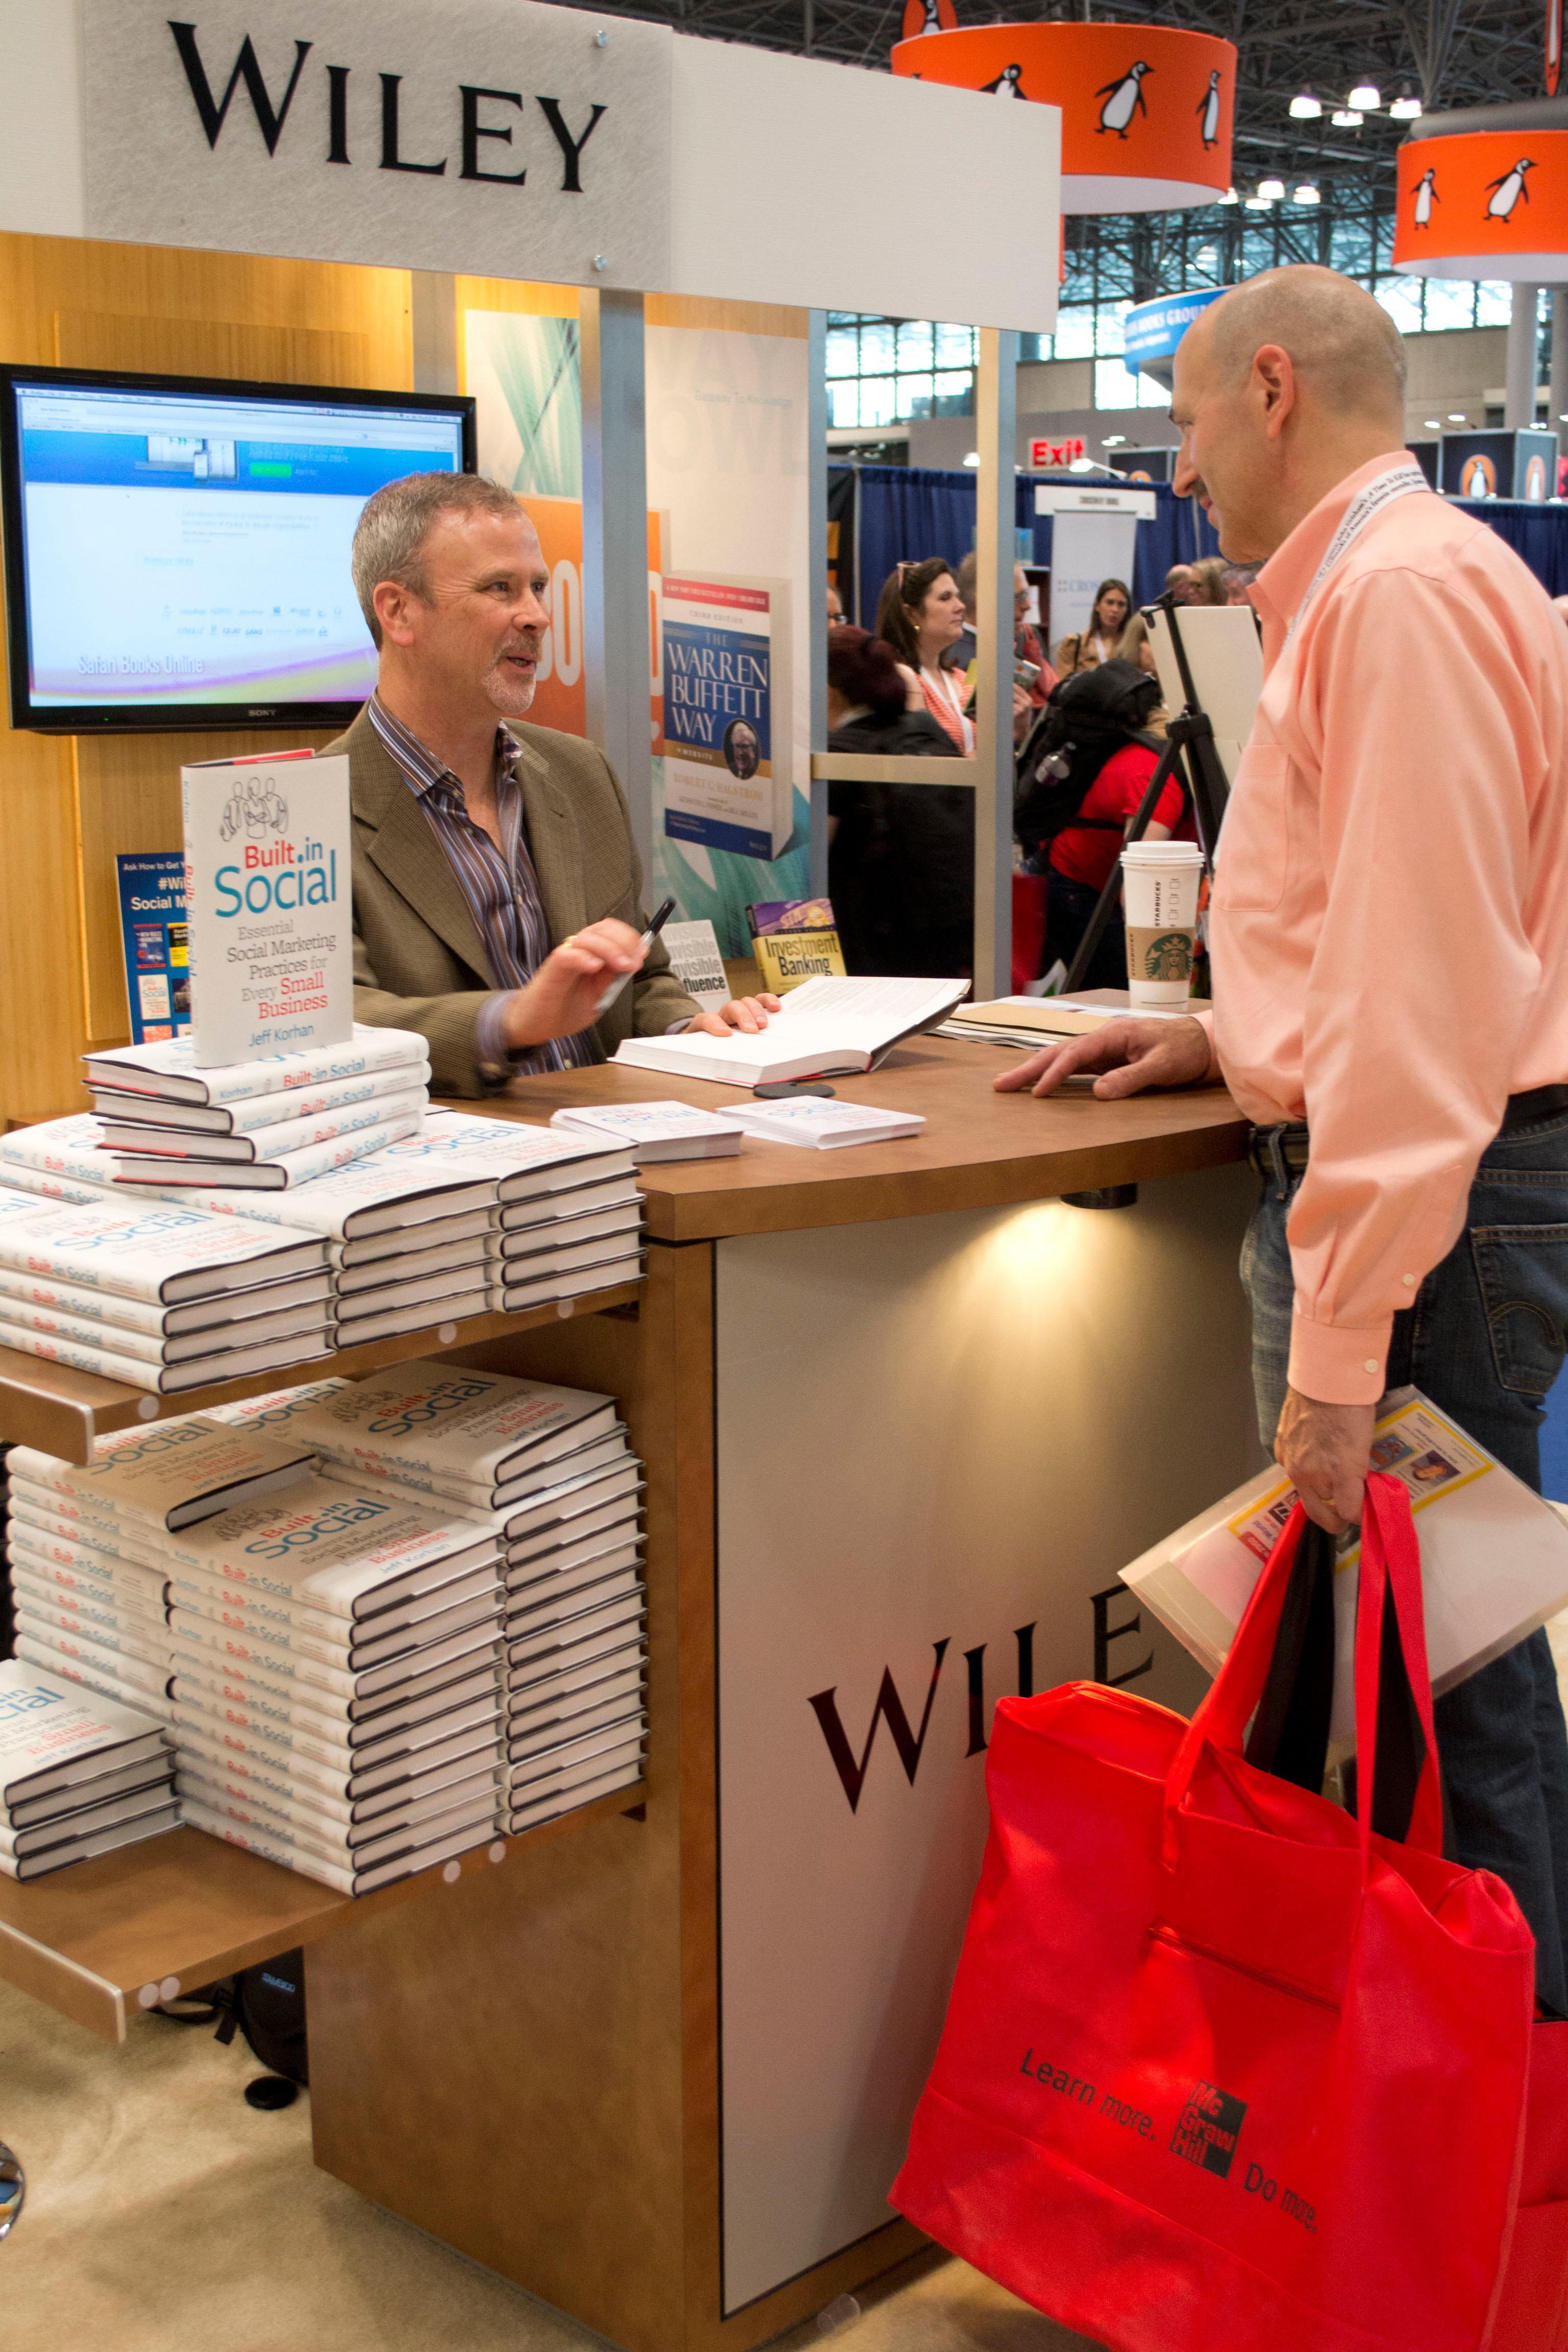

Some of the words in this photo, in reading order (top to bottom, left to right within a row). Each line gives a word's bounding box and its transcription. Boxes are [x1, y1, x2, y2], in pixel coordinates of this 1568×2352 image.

[167, 20, 608, 193] WILEY
[1032, 438, 1085, 466] Exit
[705, 632, 727, 646] THE
[78, 656, 116, 674] Safari
[120, 656, 160, 674] Books
[164, 656, 204, 673] Online
[667, 642, 768, 688] WARREN
[671, 674, 765, 718] BUFFETT
[671, 706, 716, 742] WAY
[123, 863, 137, 871] Ask
[138, 862, 155, 870] How
[156, 862, 164, 870] to
[165, 861, 179, 869] Get
[214, 849, 337, 918] Social
[131, 896, 172, 911] Social
[237, 920, 295, 941] Essential
[227, 942, 267, 963] Social
[272, 934, 337, 958] Marketing
[668, 938, 717, 959] nvisible
[765, 934, 840, 958] Investment
[249, 959, 308, 979] Practices
[310, 955, 329, 970] for
[672, 957, 722, 977] nvisible
[778, 954, 834, 976] Banking
[241, 985, 278, 1002] Every
[280, 971, 325, 995] Small
[258, 994, 329, 1020] Business
[248, 1028, 273, 1047] Jeff
[274, 1024, 315, 1043] Korhan
[219, 1086, 253, 1099] Korhan
[283, 1067, 327, 1087] Built-in
[331, 1058, 365, 1077] Social
[241, 1116, 273, 1130] Korhan
[300, 1095, 340, 1115] Built-in
[343, 1084, 375, 1104] Social
[601, 1110, 699, 1124] Social
[352, 1111, 380, 1129] Social
[364, 1132, 387, 1150] Social
[386, 1124, 526, 1158] Social
[78, 1164, 105, 1182] Social
[249, 1209, 281, 1225] Social
[53, 1210, 213, 1251] Social
[67, 1266, 99, 1285] Social
[71, 1298, 102, 1317] Social
[71, 1327, 102, 1344] Social
[71, 1353, 101, 1374] Social
[368, 1377, 498, 1437] Social
[495, 1402, 565, 1434] Business
[500, 1399, 547, 1423] Small
[186, 1453, 265, 1481] Business
[244, 1498, 391, 1559] Social
[301, 1545, 341, 1565] Social
[346, 1514, 422, 1547] Marketing
[380, 1527, 431, 1550] Small
[335, 1530, 400, 1559] Practices
[368, 1530, 450, 1564] Business
[87, 1560, 113, 1580] Social
[381, 1558, 405, 1574] Jeff
[406, 1542, 451, 1563] Korhan
[262, 1577, 292, 1597] Social
[260, 1604, 291, 1625] Social
[260, 1626, 290, 1646] Social
[264, 1656, 296, 1676] Social
[261, 1701, 290, 1724] Social
[26, 1724, 112, 1755] Business
[40, 1720, 97, 1741] Small
[263, 1725, 293, 1747] Social
[1020, 2048, 1097, 2106] Learn
[1098, 2094, 1156, 2141] more.
[1190, 2083, 1223, 2117] Mc
[1180, 2105, 1238, 2152] Graw
[1172, 2130, 1209, 2166] Hill
[1243, 2161, 1278, 2201] Do
